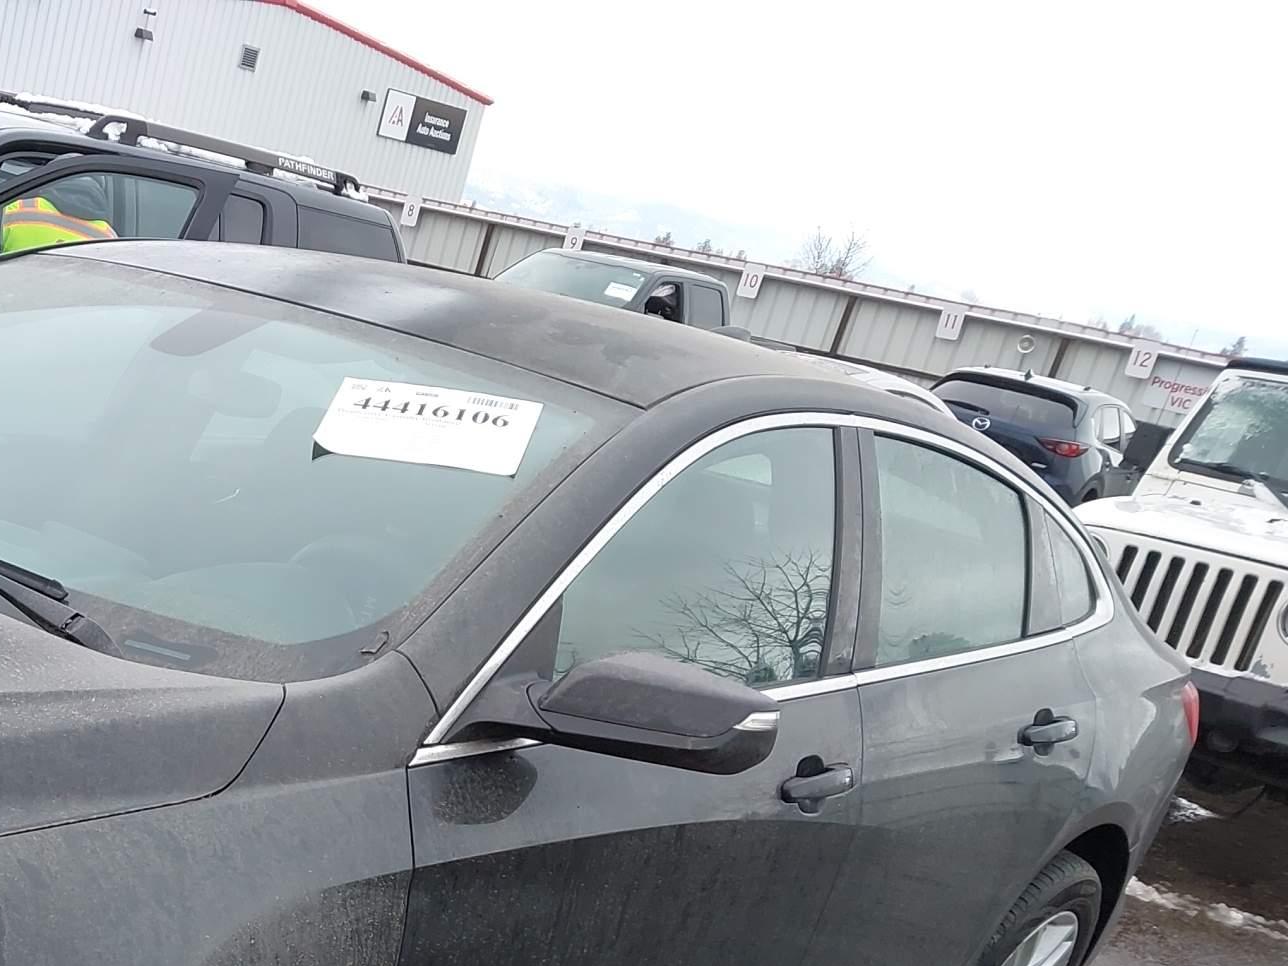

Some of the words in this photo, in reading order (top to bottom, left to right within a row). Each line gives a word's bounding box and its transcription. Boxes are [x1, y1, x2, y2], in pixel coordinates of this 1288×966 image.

[424, 112, 450, 128] Insurance
[416, 122, 430, 136] Auto
[429, 126, 451, 141] Auctions
[278, 157, 335, 181] PATHFINDER
[407, 204, 415, 217] 8
[570, 236, 578, 249] 9
[743, 273, 759, 289] 10
[944, 313, 958, 329] 11
[1133, 350, 1152, 368] 12
[1171, 396, 1192, 410] VIC
[353, 396, 511, 428] 44416106
